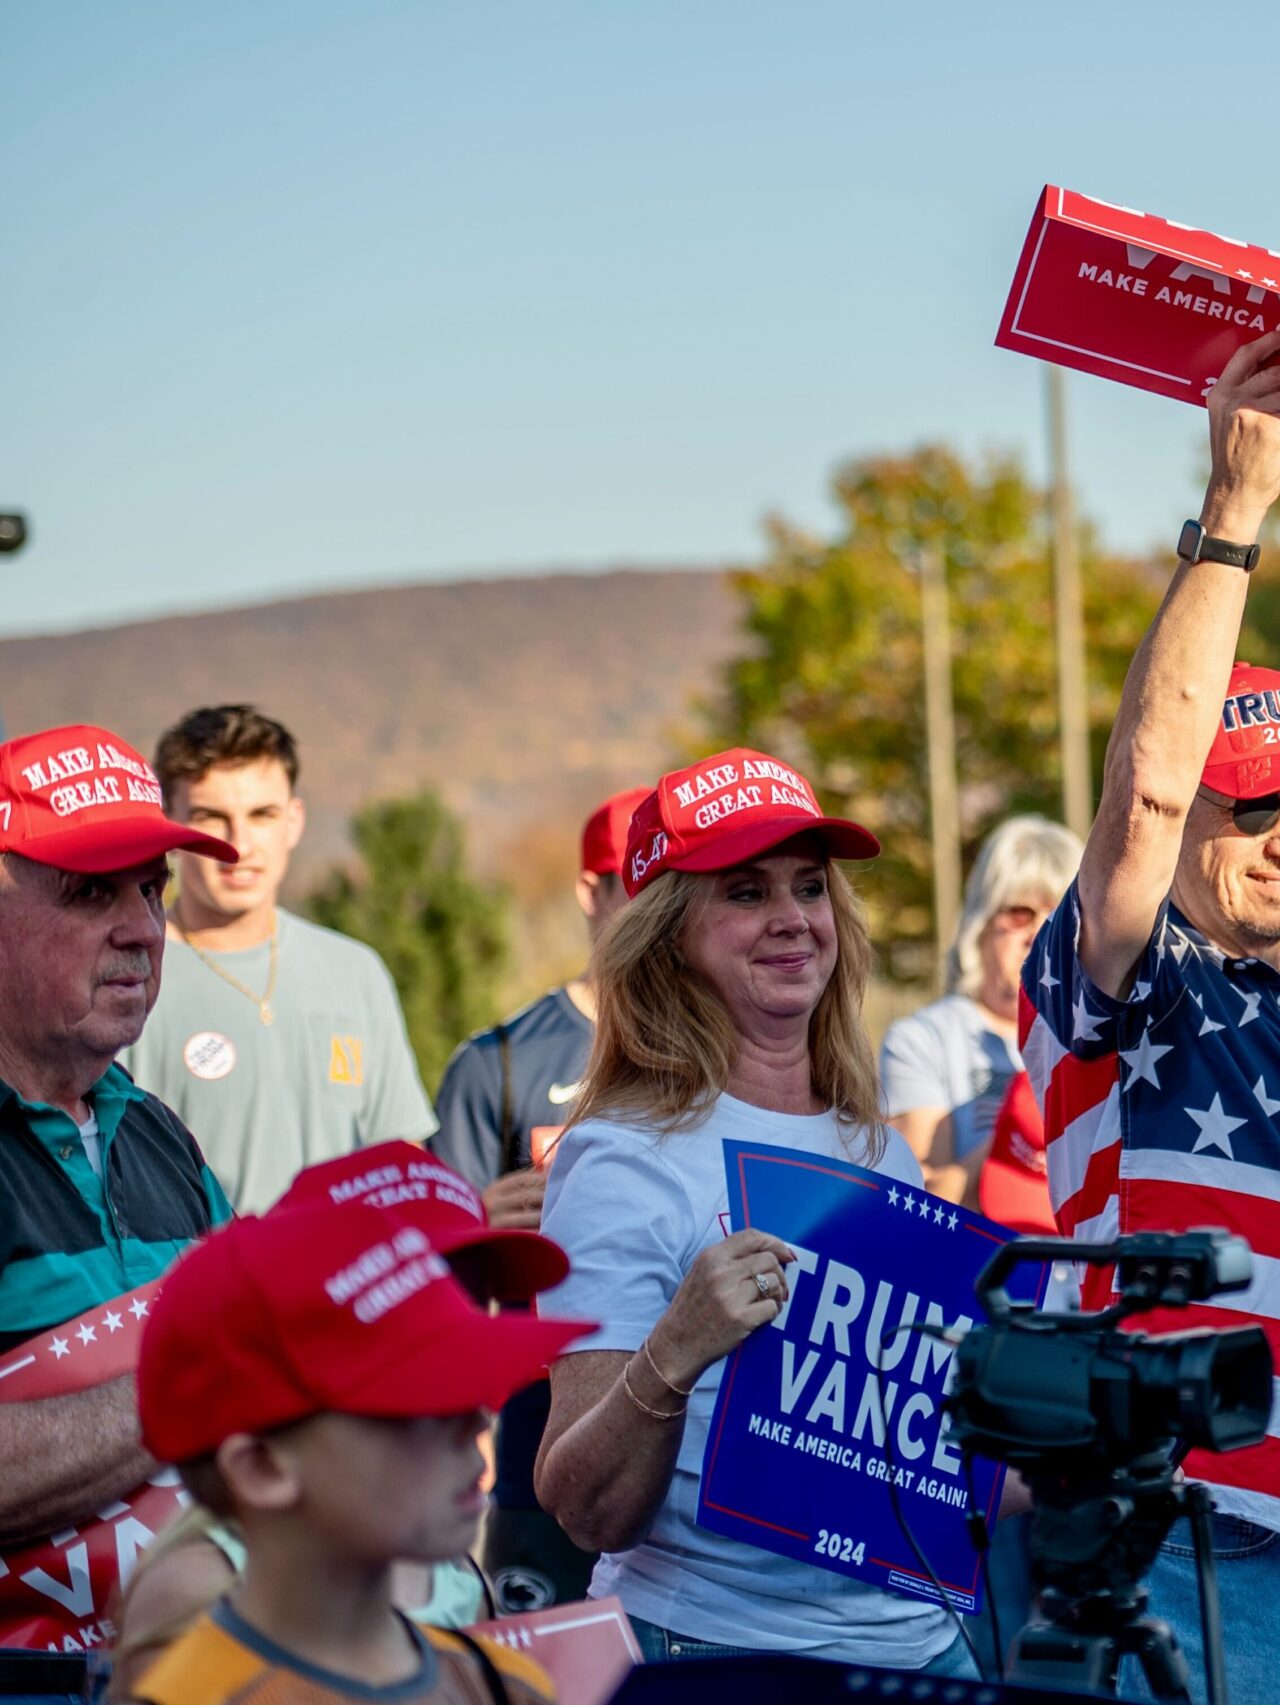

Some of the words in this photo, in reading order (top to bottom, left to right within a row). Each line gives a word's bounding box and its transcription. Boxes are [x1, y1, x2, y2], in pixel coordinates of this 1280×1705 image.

[1078, 262, 1149, 296] MAKE
[1154, 286, 1264, 331] AMERICA
[21, 746, 94, 791] MAKE
[673, 764, 739, 808] MAKE
[50, 775, 122, 817] GREAT
[695, 785, 764, 829] GREAT
[770, 1240, 974, 1396] TRUM
[748, 1413, 792, 1446] MAKE
[794, 1431, 861, 1472] AMERICA
[866, 1457, 915, 1490] GREAT
[916, 1476, 968, 1509] AGAIN!
[814, 1529, 866, 1566] 2024
